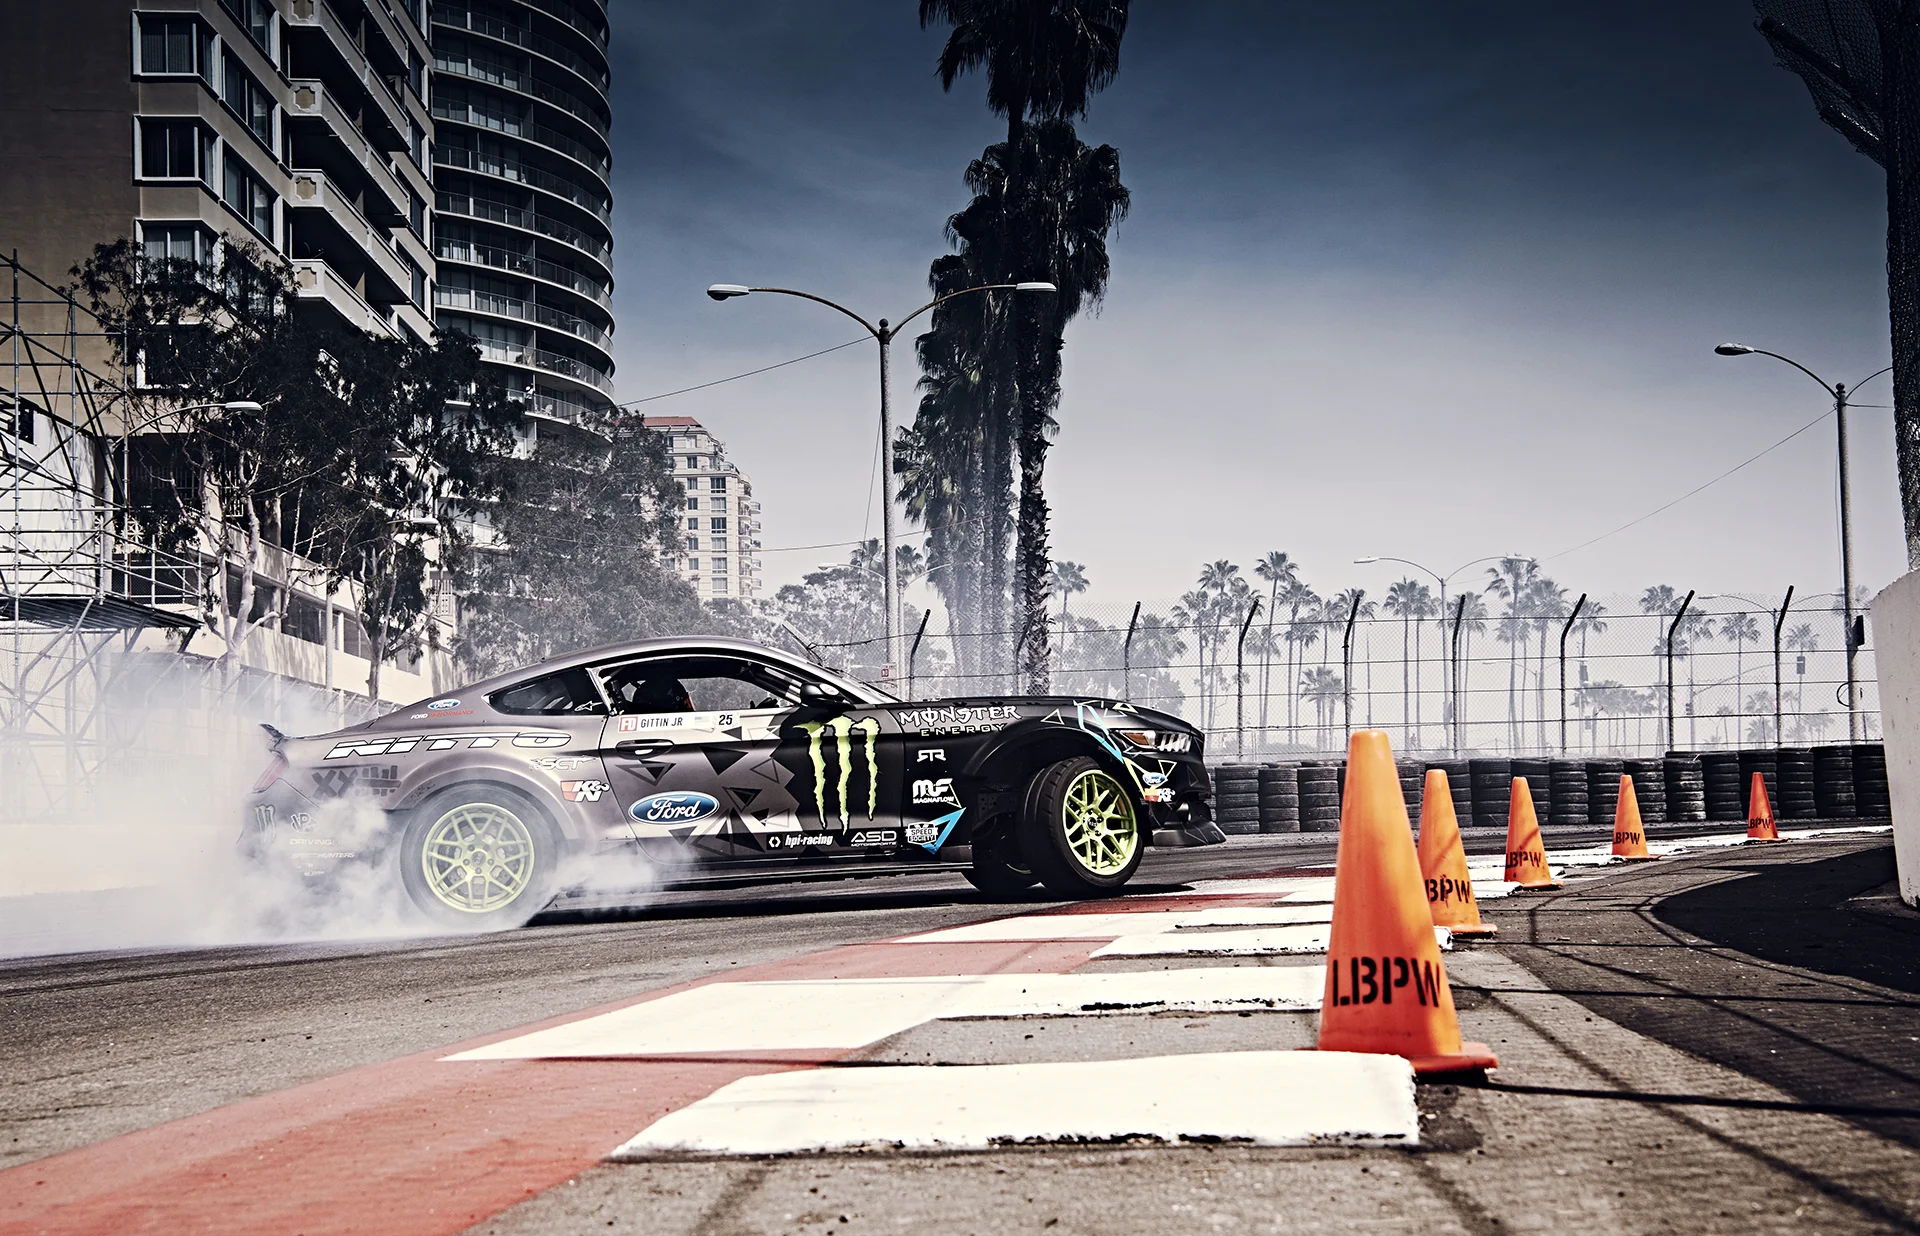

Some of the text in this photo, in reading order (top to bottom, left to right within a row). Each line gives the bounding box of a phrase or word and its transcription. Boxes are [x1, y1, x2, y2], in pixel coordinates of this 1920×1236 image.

[428, 709, 475, 717] PERFORMANCE
[718, 714, 733, 726] 25
[899, 705, 1021, 727] MONSTER
[640, 718, 669, 728] GITTIN
[671, 717, 683, 727] JR
[921, 722, 1006, 737] ENERGY
[323, 731, 572, 760] NITTO
[541, 756, 581, 771] SCT
[913, 796, 955, 804] MAGNAFLOW
[647, 796, 701, 820] Ford
[851, 830, 897, 843] ASD
[911, 828, 933, 836] SPEED
[785, 833, 833, 848] hpi-racing
[1425, 878, 1470, 904] BPW
[1333, 957, 1440, 1007] LBPW
